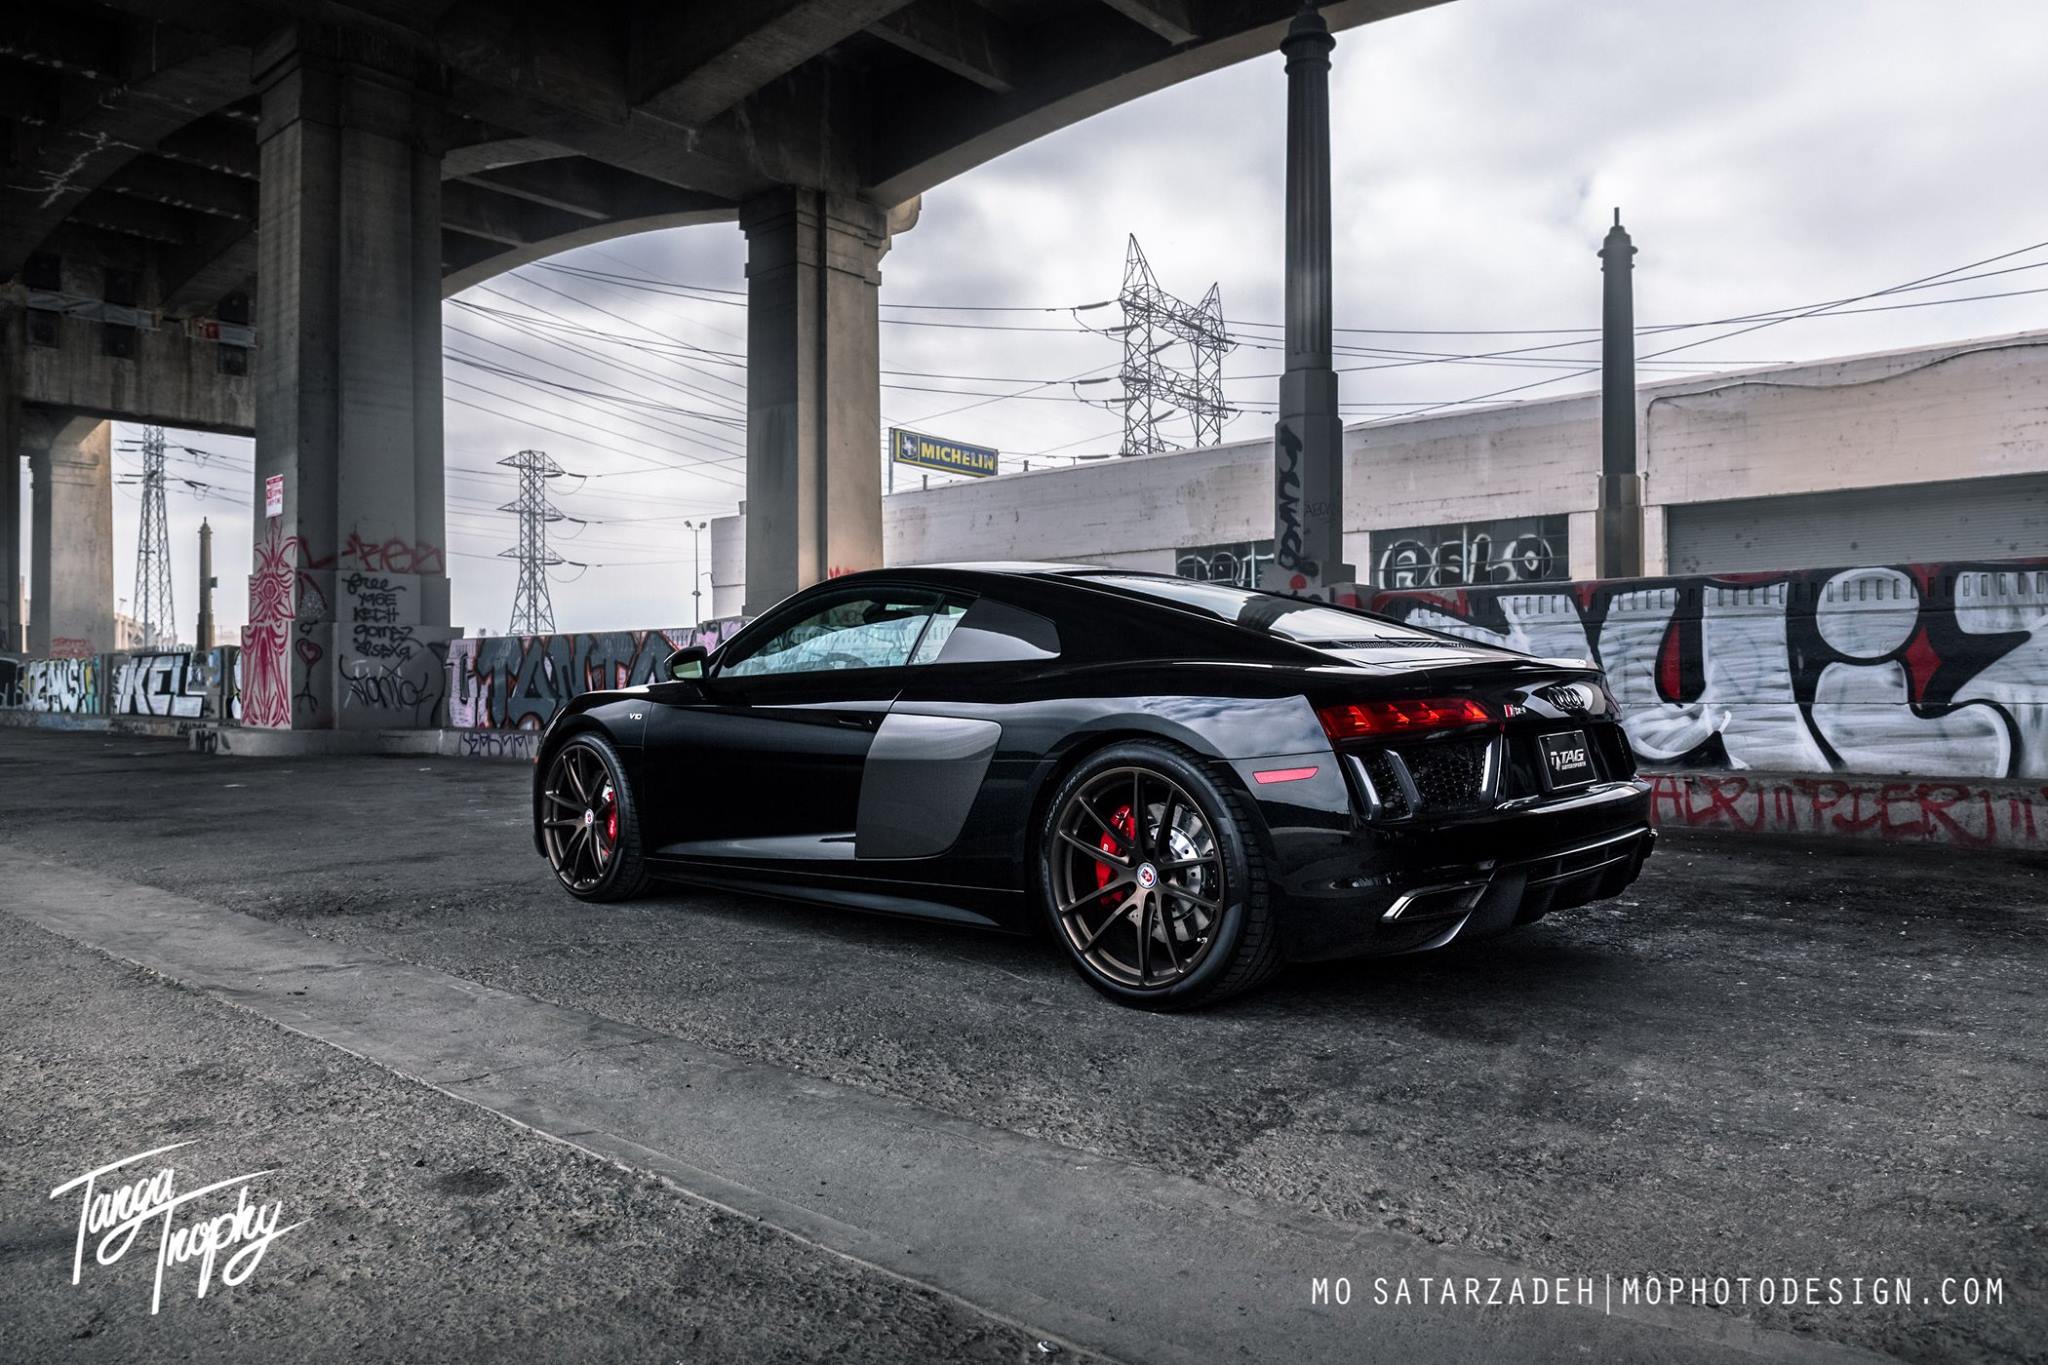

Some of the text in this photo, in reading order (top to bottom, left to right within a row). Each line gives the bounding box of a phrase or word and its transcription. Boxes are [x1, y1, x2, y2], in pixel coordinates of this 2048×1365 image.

[921, 442, 994, 471] MICHELIN
[629, 712, 643, 720] V10
[1560, 749, 1584, 764] TAG
